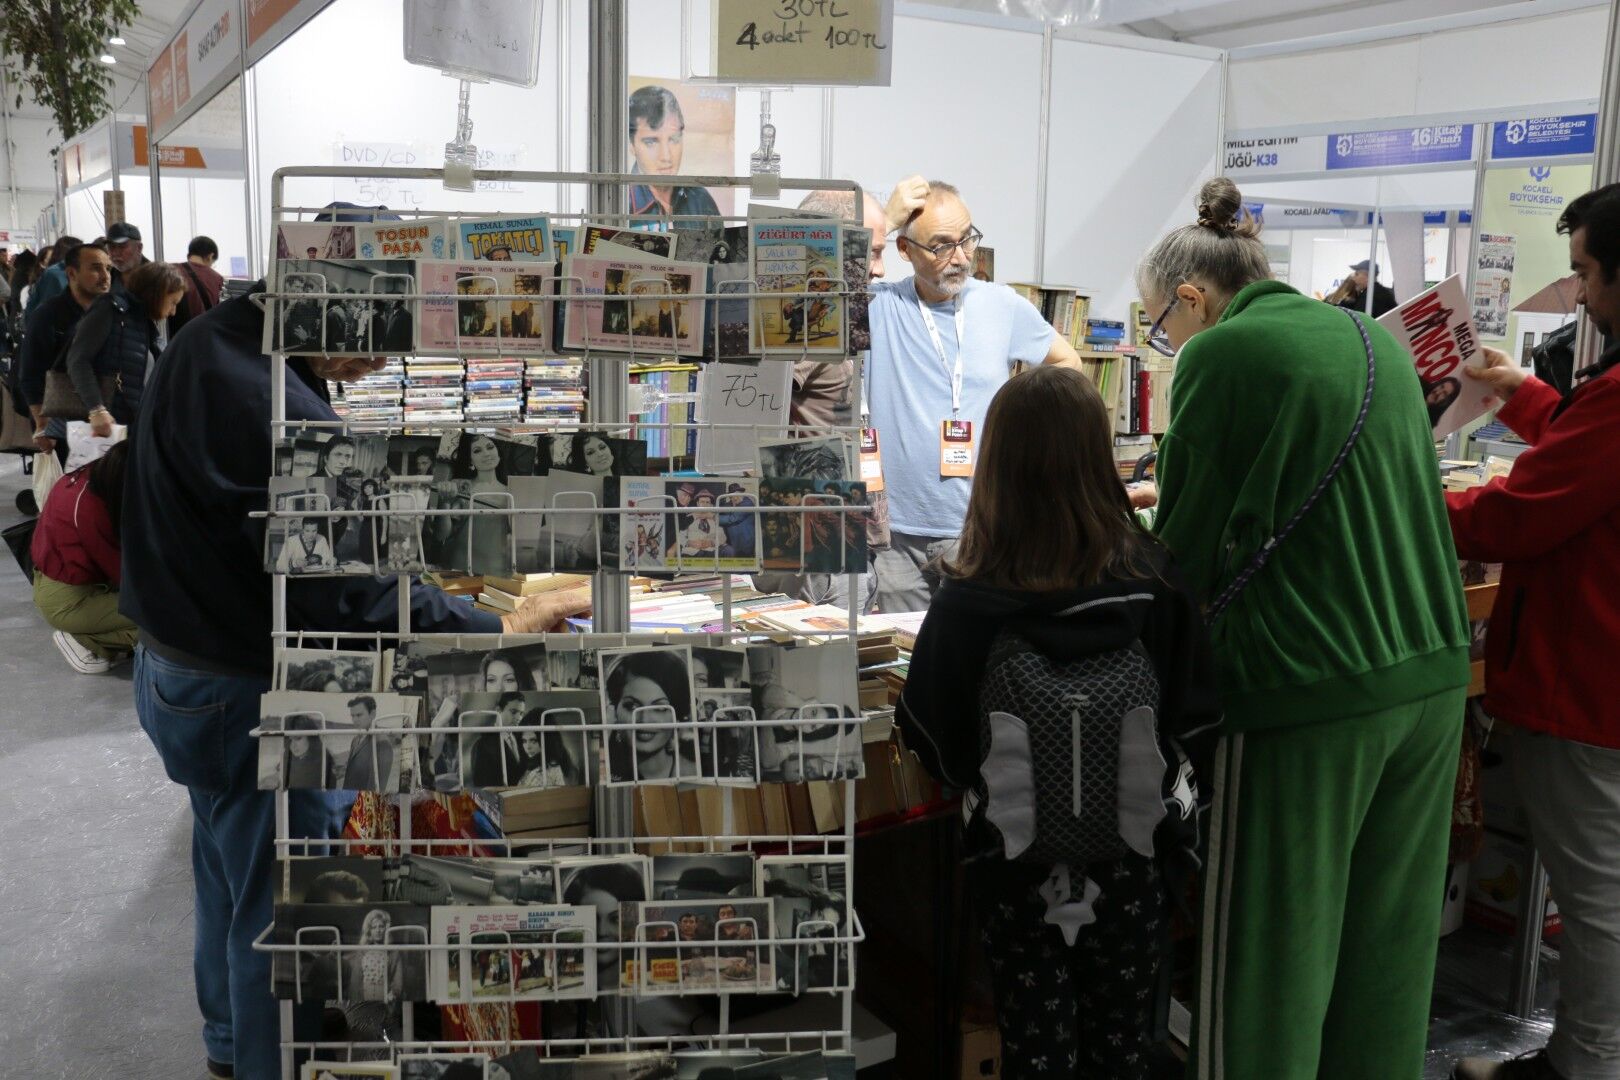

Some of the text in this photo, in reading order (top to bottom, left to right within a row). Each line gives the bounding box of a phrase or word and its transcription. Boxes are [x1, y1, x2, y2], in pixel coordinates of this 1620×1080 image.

[736, 22, 760, 50] 4
[762, 22, 810, 44] adet
[1411, 128, 1432, 146] 16
[474, 218, 534, 231] KEMAL SUNAL
[375, 226, 429, 243] TOSUN
[383, 241, 423, 255] PAŞA
[1453, 321, 1476, 361] MEGA
